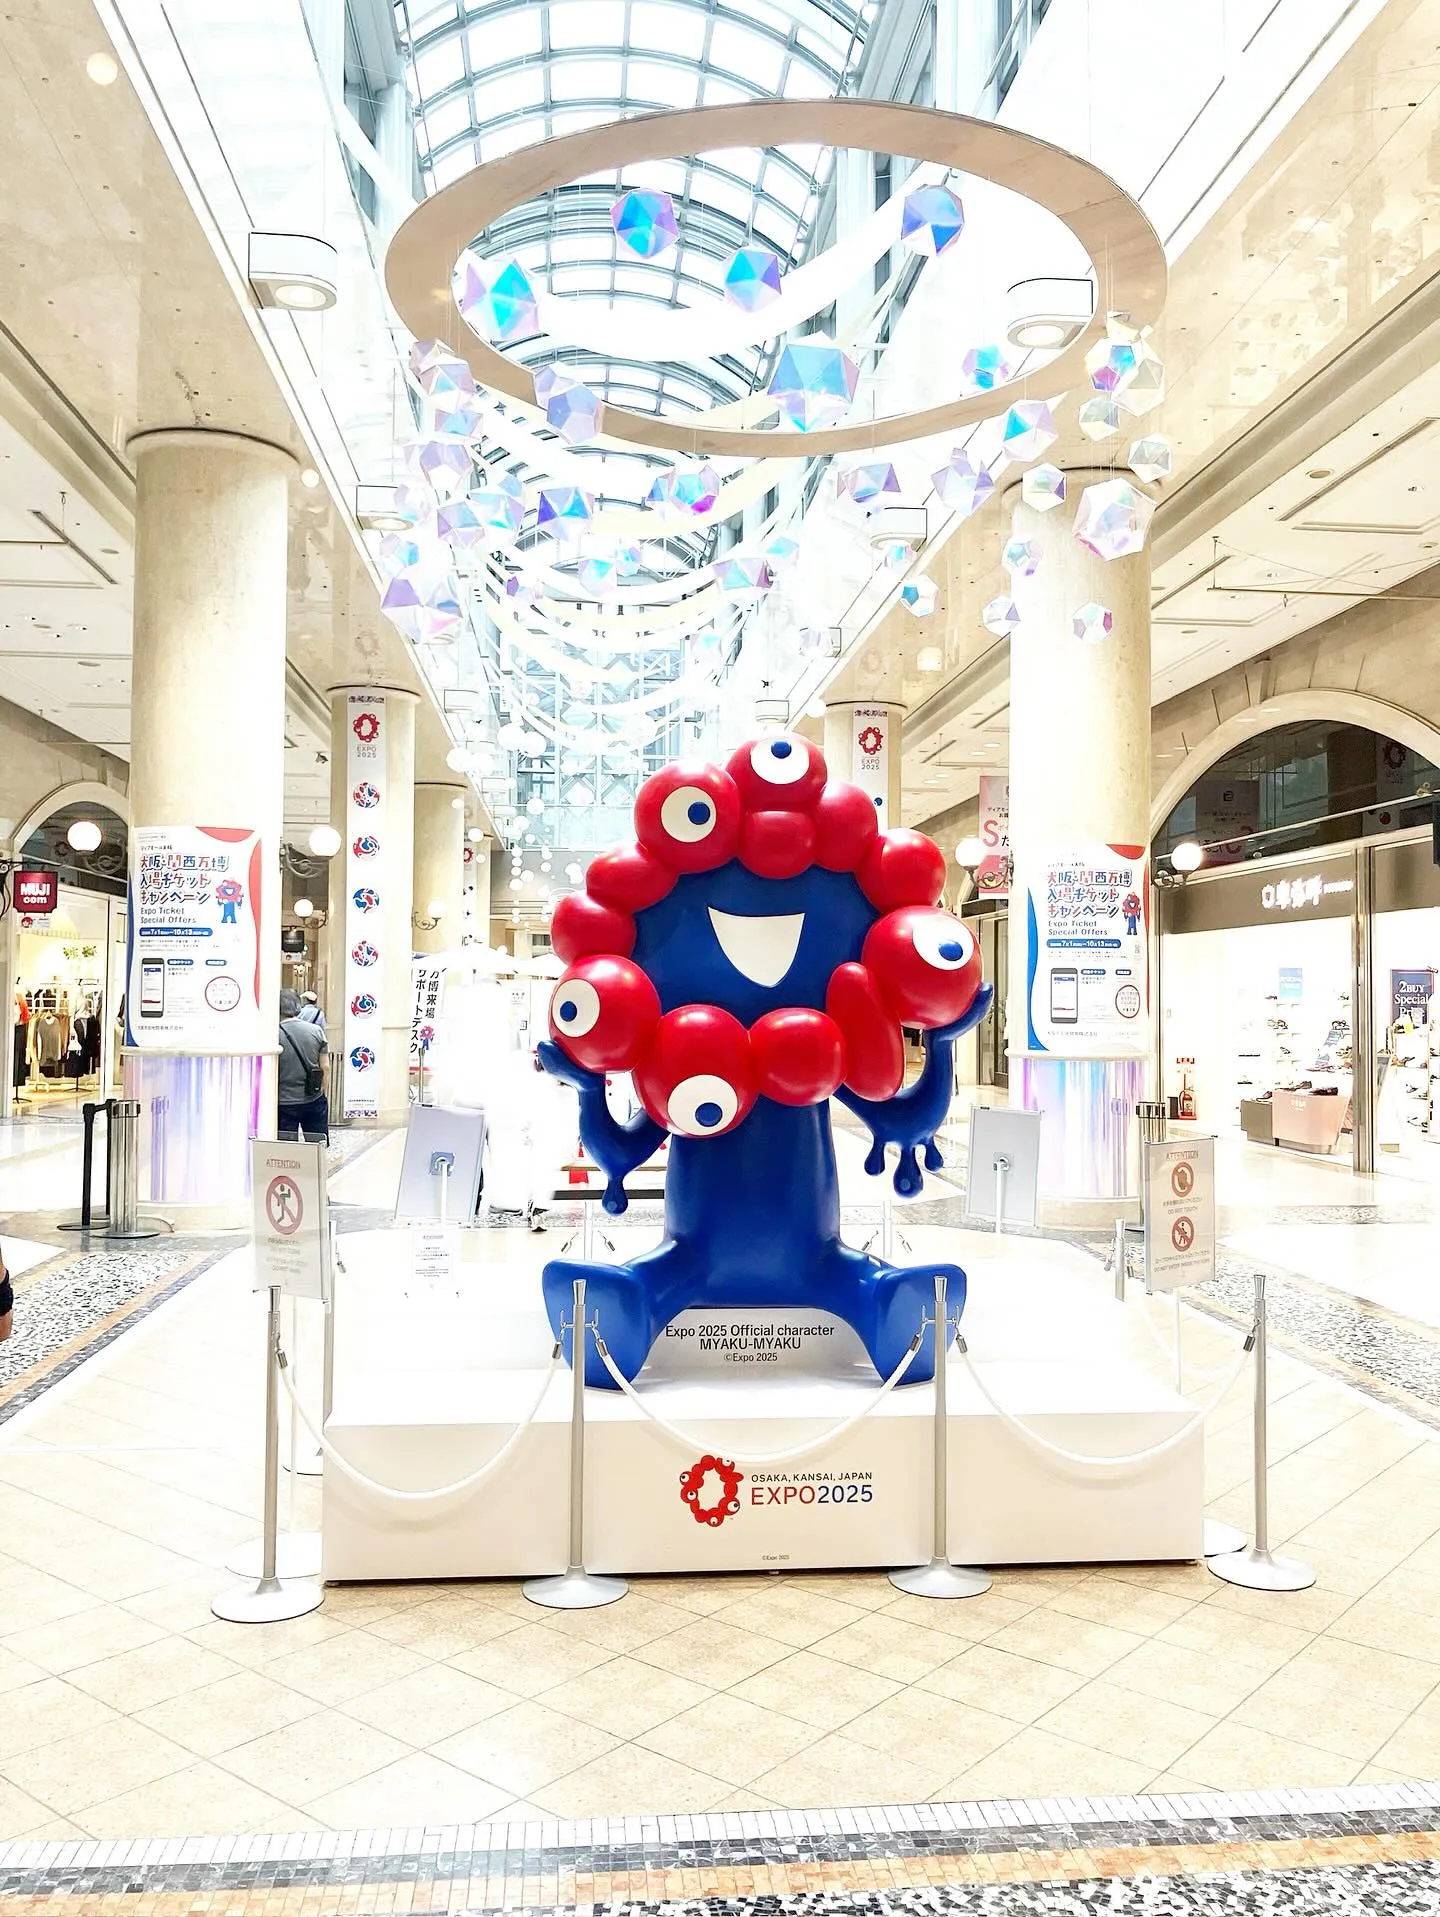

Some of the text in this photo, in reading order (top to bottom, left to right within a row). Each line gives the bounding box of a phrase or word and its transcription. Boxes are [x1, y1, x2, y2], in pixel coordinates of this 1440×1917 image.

[140, 872, 210, 888] 入場チケット
[20, 883, 50, 896] MUJI
[1047, 887, 1118, 902] 入場チケット
[23, 896, 47, 904] com
[140, 889, 210, 904] キャンペーン
[140, 907, 184, 915] Expo Ticket
[1047, 903, 1118, 918] キャンペーン
[140, 916, 197, 924] Special Offers
[1071, 919, 1097, 927] Ticket
[1048, 928, 1108, 936] Special Offers
[1398, 980, 1425, 993] 2BUY
[1394, 993, 1429, 1006] Special
[1165, 1150, 1199, 1161] ATTENTION
[266, 1158, 301, 1169] ATTENTION
[665, 1323, 835, 1339] Expo 2025 Official character
[699, 1337, 801, 1350] MYAKU-MYAKU
[724, 1352, 778, 1362] ©Expo 2025
[751, 1472, 873, 1483] OSAKA, KANSAI, JAPAN
[751, 1485, 873, 1506] EXPO2025
